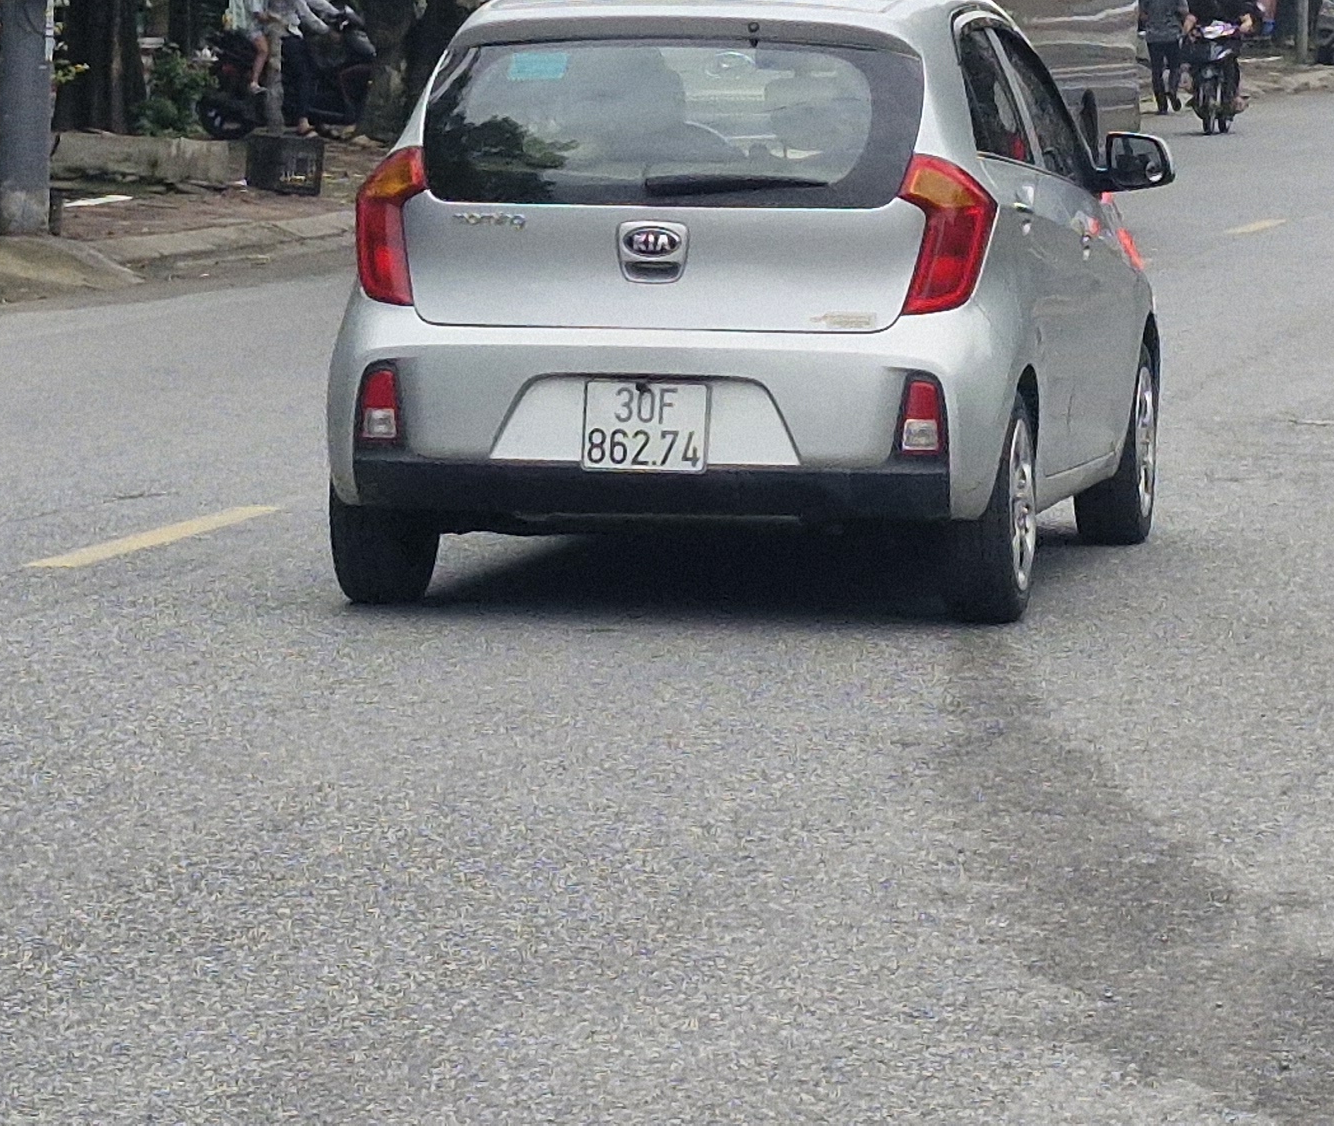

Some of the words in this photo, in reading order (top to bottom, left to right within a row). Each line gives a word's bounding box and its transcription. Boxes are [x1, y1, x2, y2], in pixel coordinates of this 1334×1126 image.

[632, 233, 671, 250] KIA
[613, 386, 678, 425] 30F
[587, 427, 700, 467] 862.74
